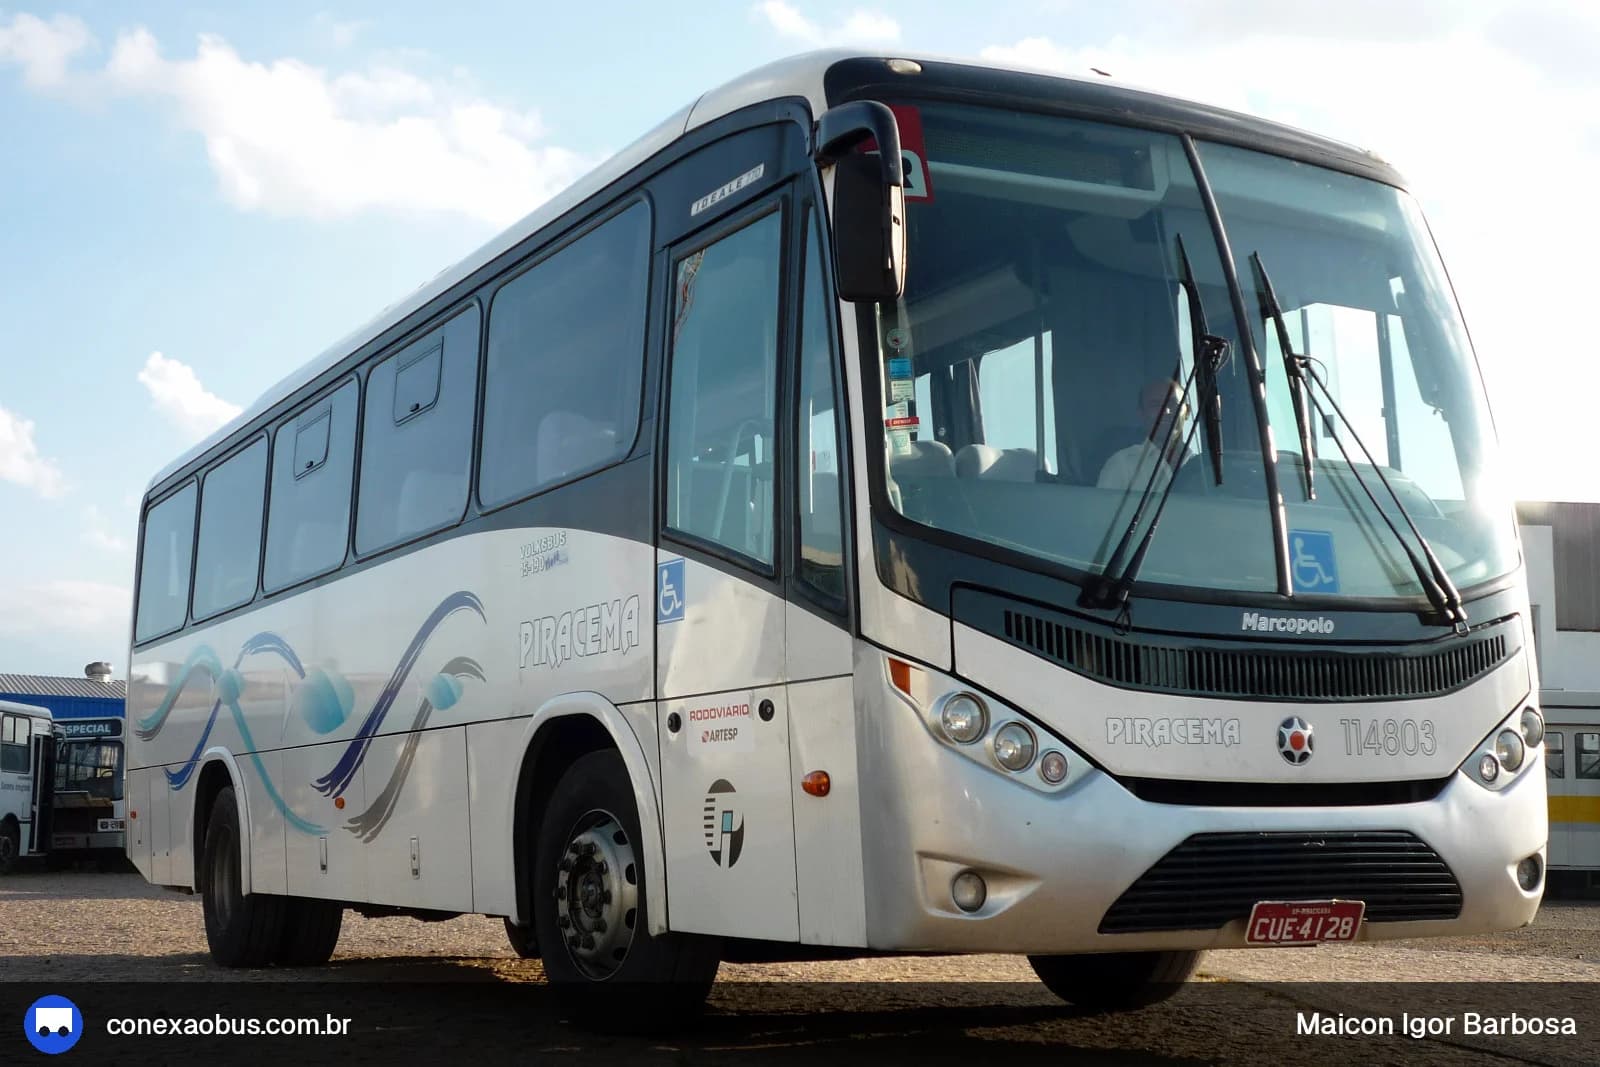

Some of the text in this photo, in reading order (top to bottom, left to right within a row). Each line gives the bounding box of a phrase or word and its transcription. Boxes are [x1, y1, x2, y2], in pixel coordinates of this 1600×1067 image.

[696, 178, 743, 211] IDEALE
[520, 531, 567, 560] VOLKSBUS
[519, 594, 640, 669] PIRACEMA
[1241, 613, 1335, 634] Marcopolo
[64, 723, 112, 735] SPECIAL
[709, 727, 738, 743] ARTESP
[1105, 717, 1241, 748] PIRACEMA
[1339, 718, 1437, 756] 114803
